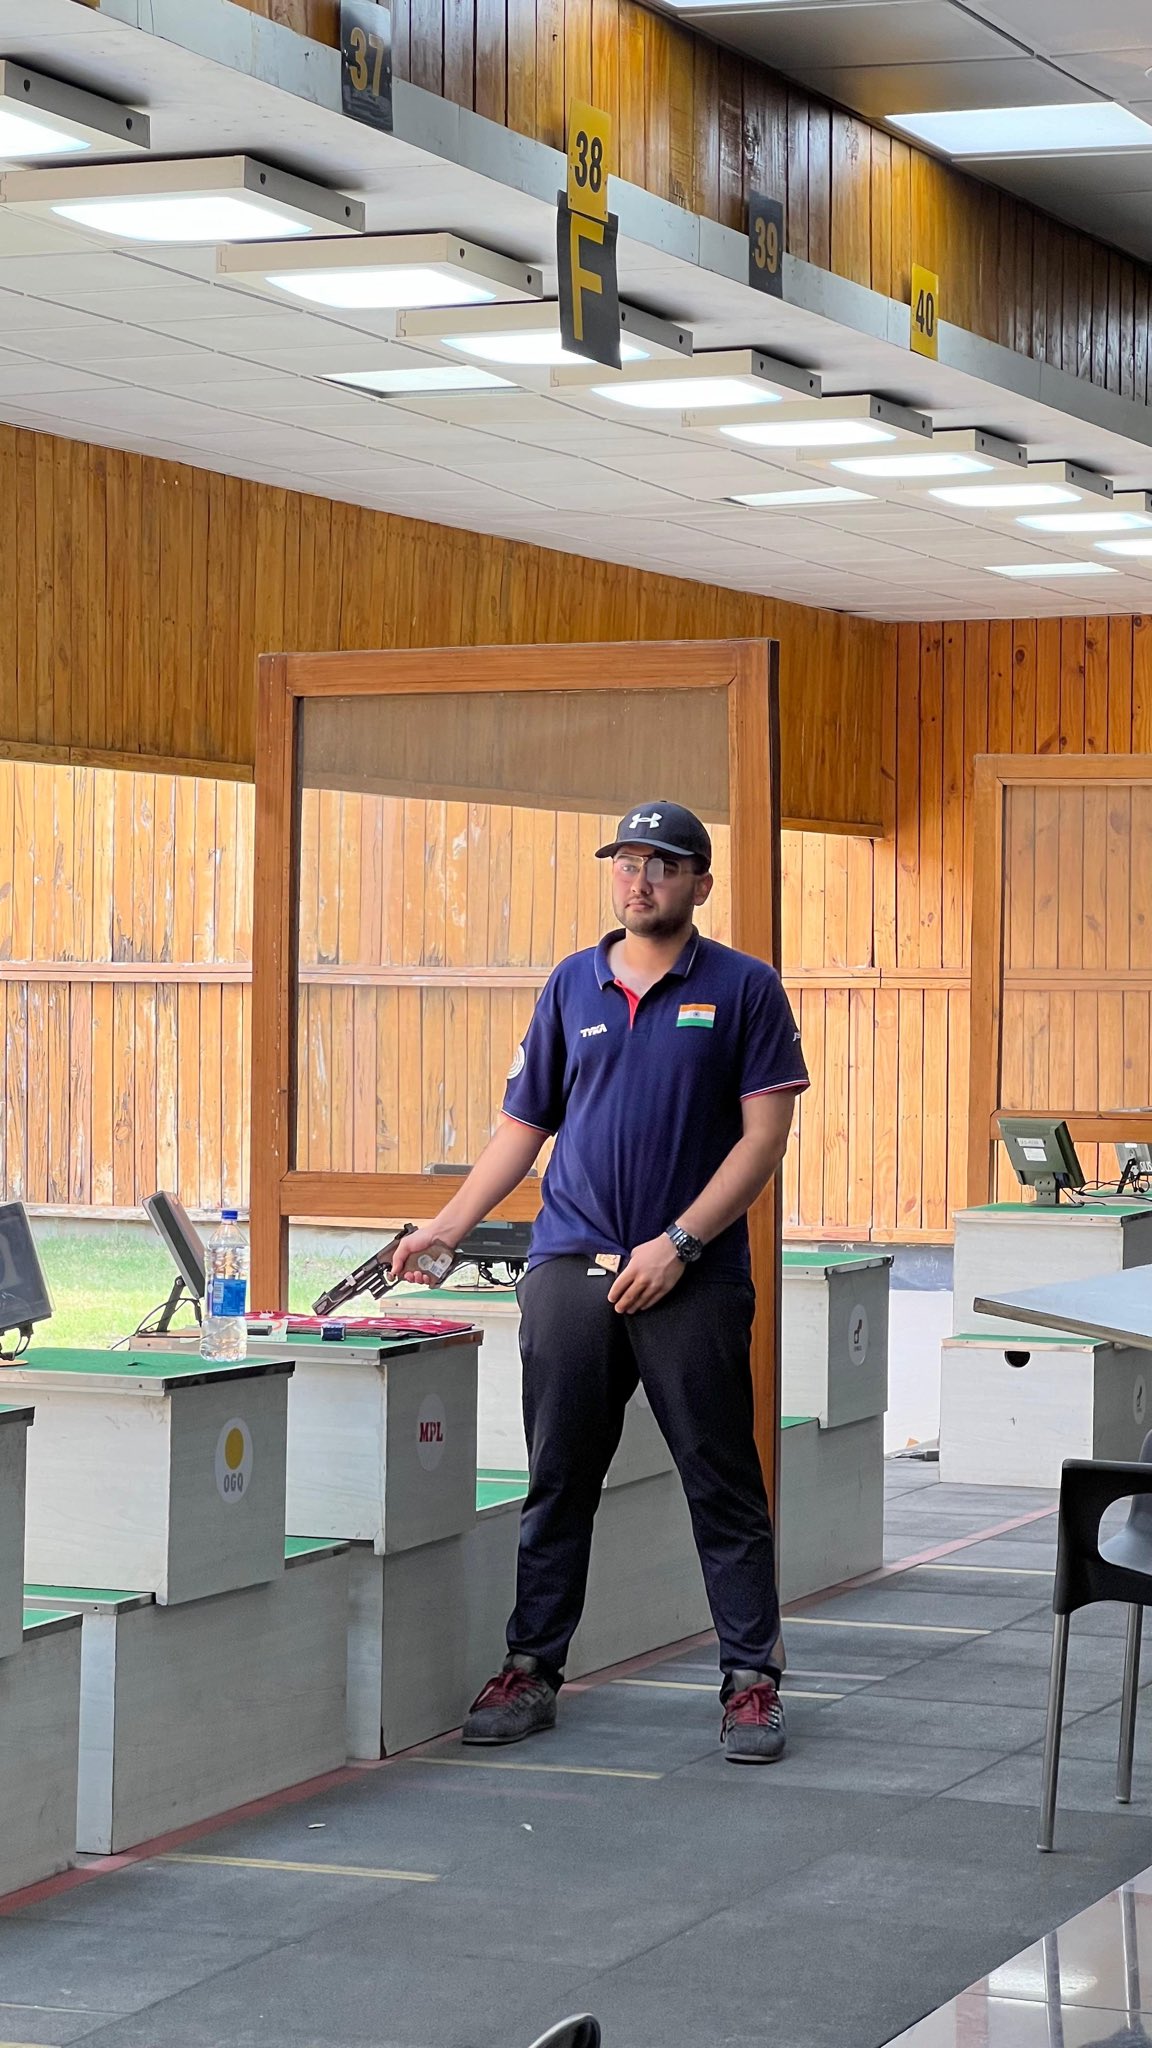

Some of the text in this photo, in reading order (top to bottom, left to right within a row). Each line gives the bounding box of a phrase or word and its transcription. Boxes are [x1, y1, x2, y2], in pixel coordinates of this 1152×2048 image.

[350, 27, 384, 97] 37
[574, 131, 603, 193] 38
[755, 216, 778, 274] 39
[570, 212, 605, 341] F
[915, 289, 934, 338] 40
[419, 1421, 443, 1443] MPL
[223, 1472, 244, 1494] OGQ
